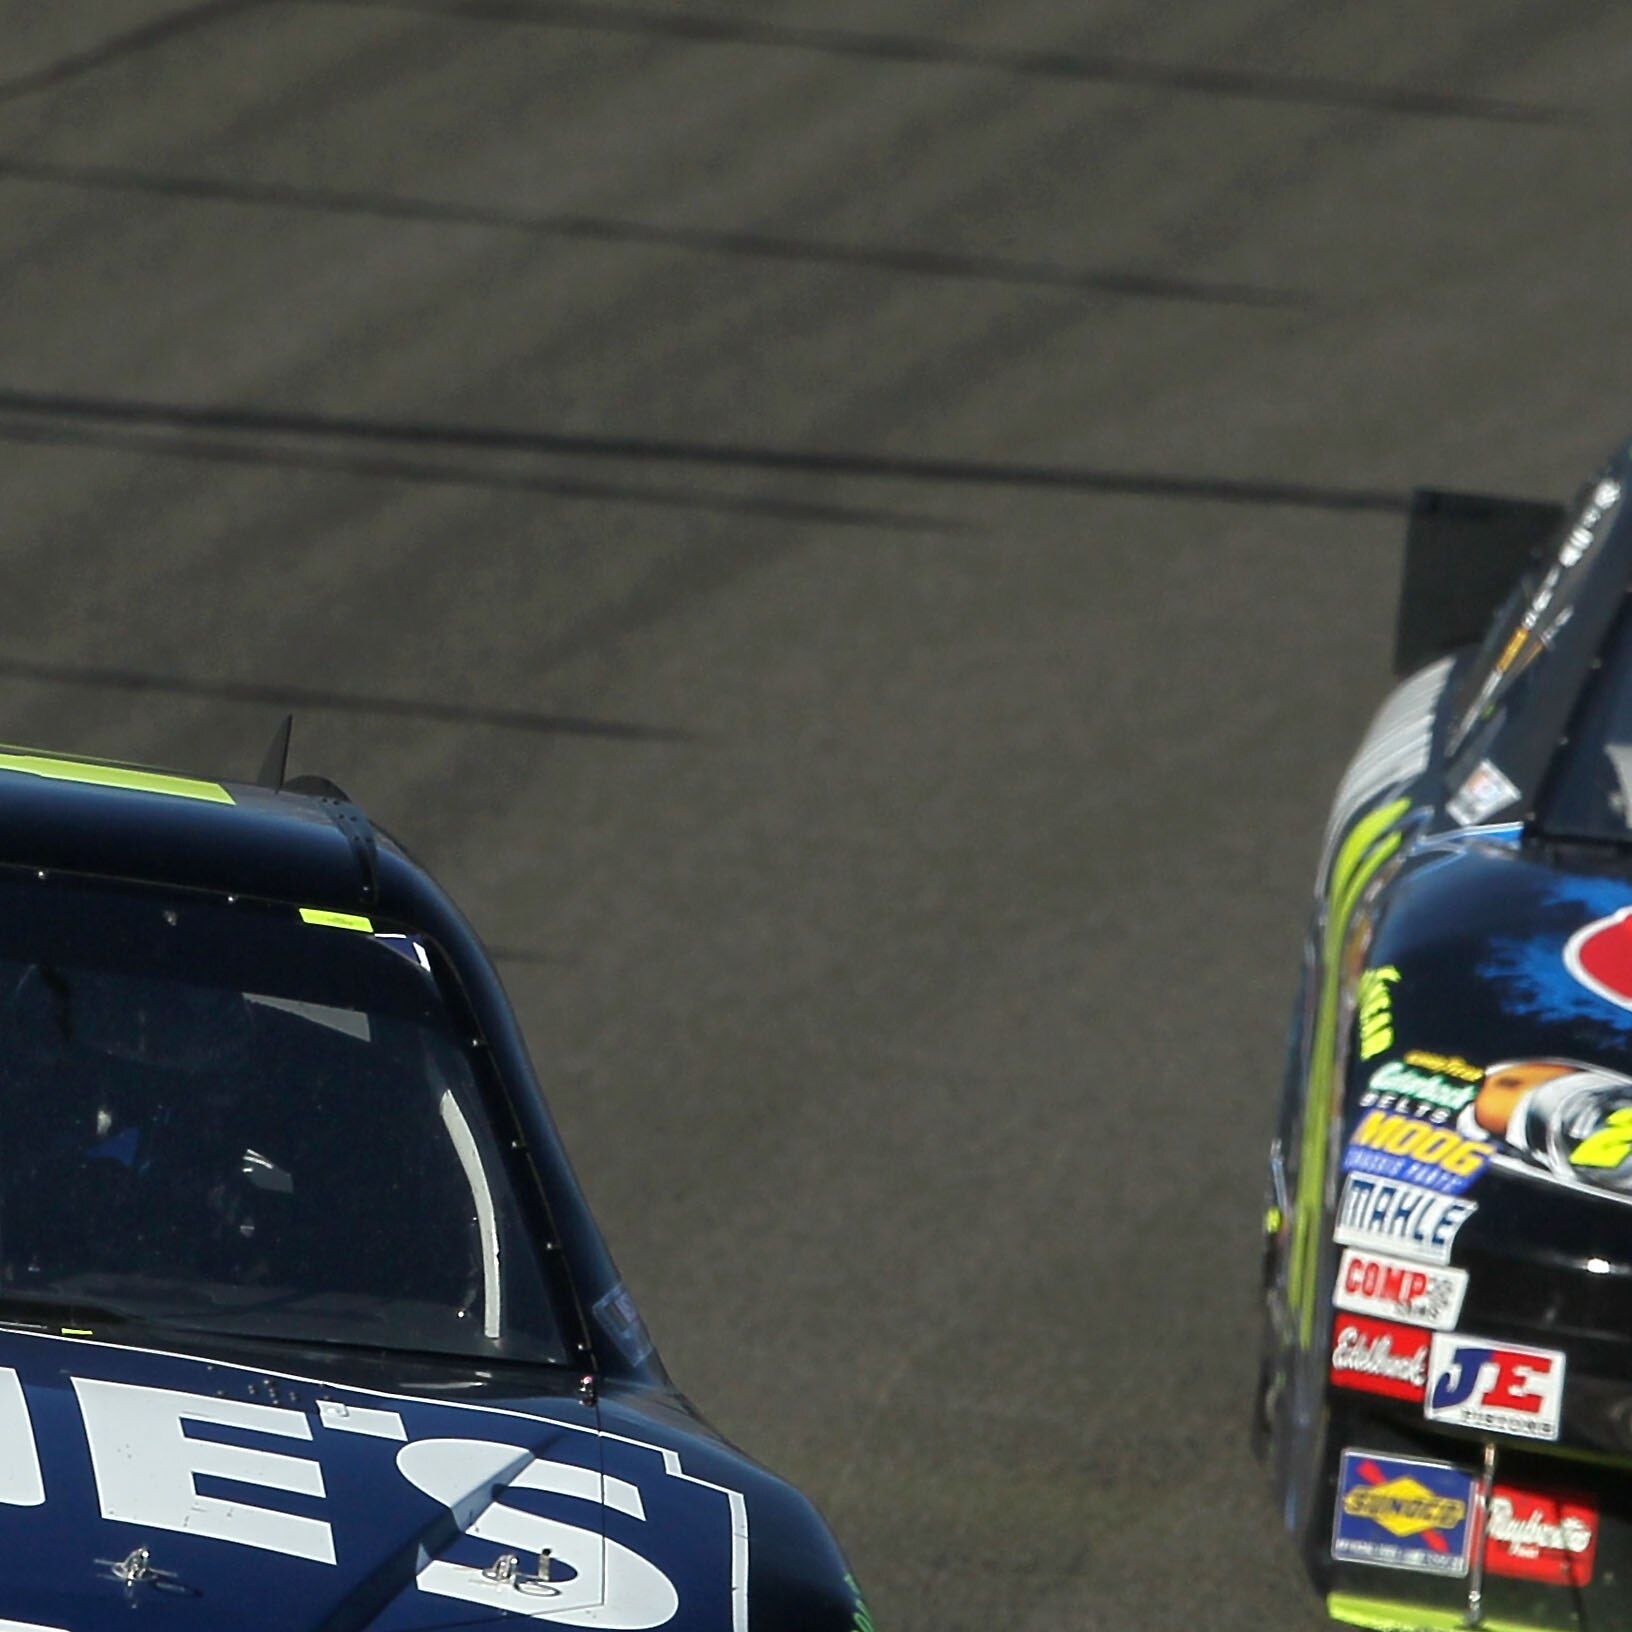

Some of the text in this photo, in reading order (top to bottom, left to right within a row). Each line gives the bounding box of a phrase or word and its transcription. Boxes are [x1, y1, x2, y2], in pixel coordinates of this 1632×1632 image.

[1360, 1092, 1452, 1125] BELTS
[1352, 1110, 1497, 1178] MOOG
[1345, 1258, 1428, 1307] COMP
